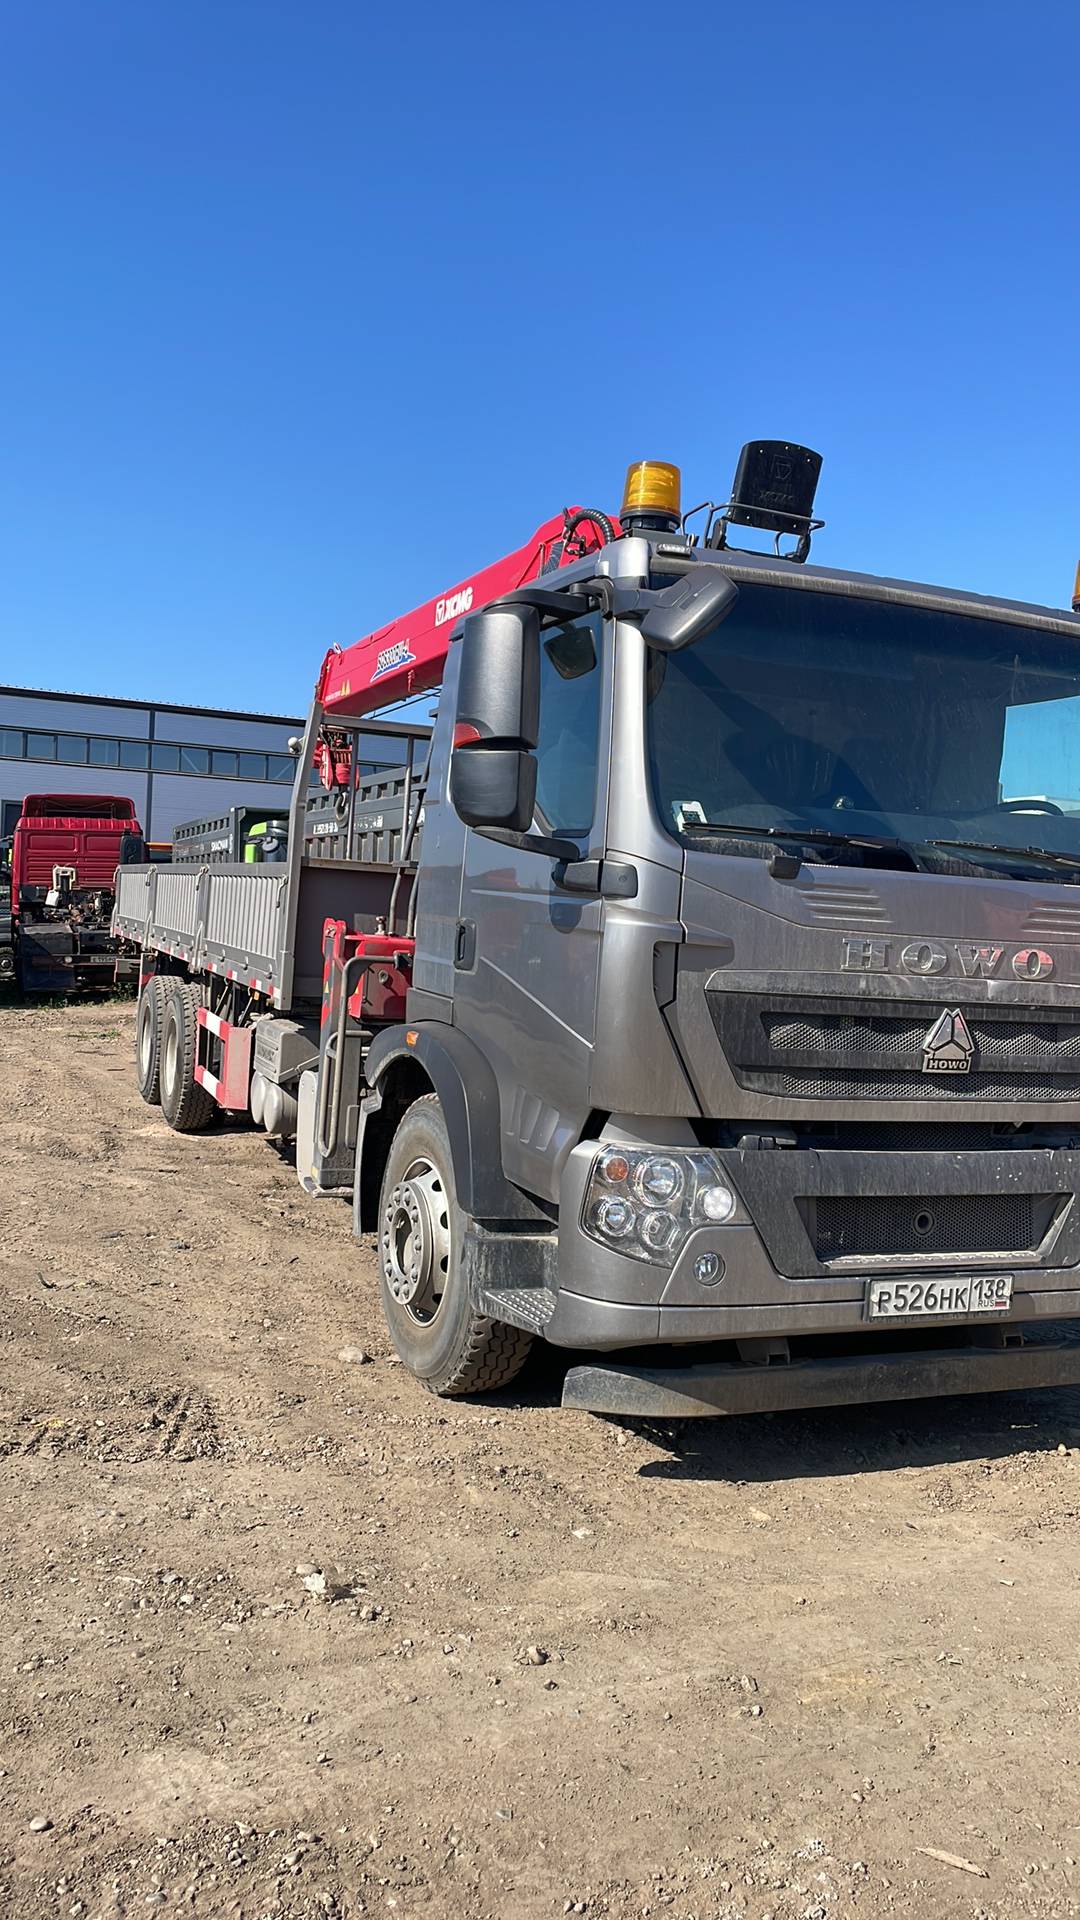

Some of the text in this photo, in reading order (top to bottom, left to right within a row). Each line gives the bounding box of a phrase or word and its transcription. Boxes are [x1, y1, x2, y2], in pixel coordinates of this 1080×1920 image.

[442, 586, 474, 620] XCMG
[840, 938, 1055, 980] HOWO
[928, 1058, 967, 1070] HOWO
[973, 1279, 1006, 1301] 138
[977, 1300, 995, 1309] RUS
